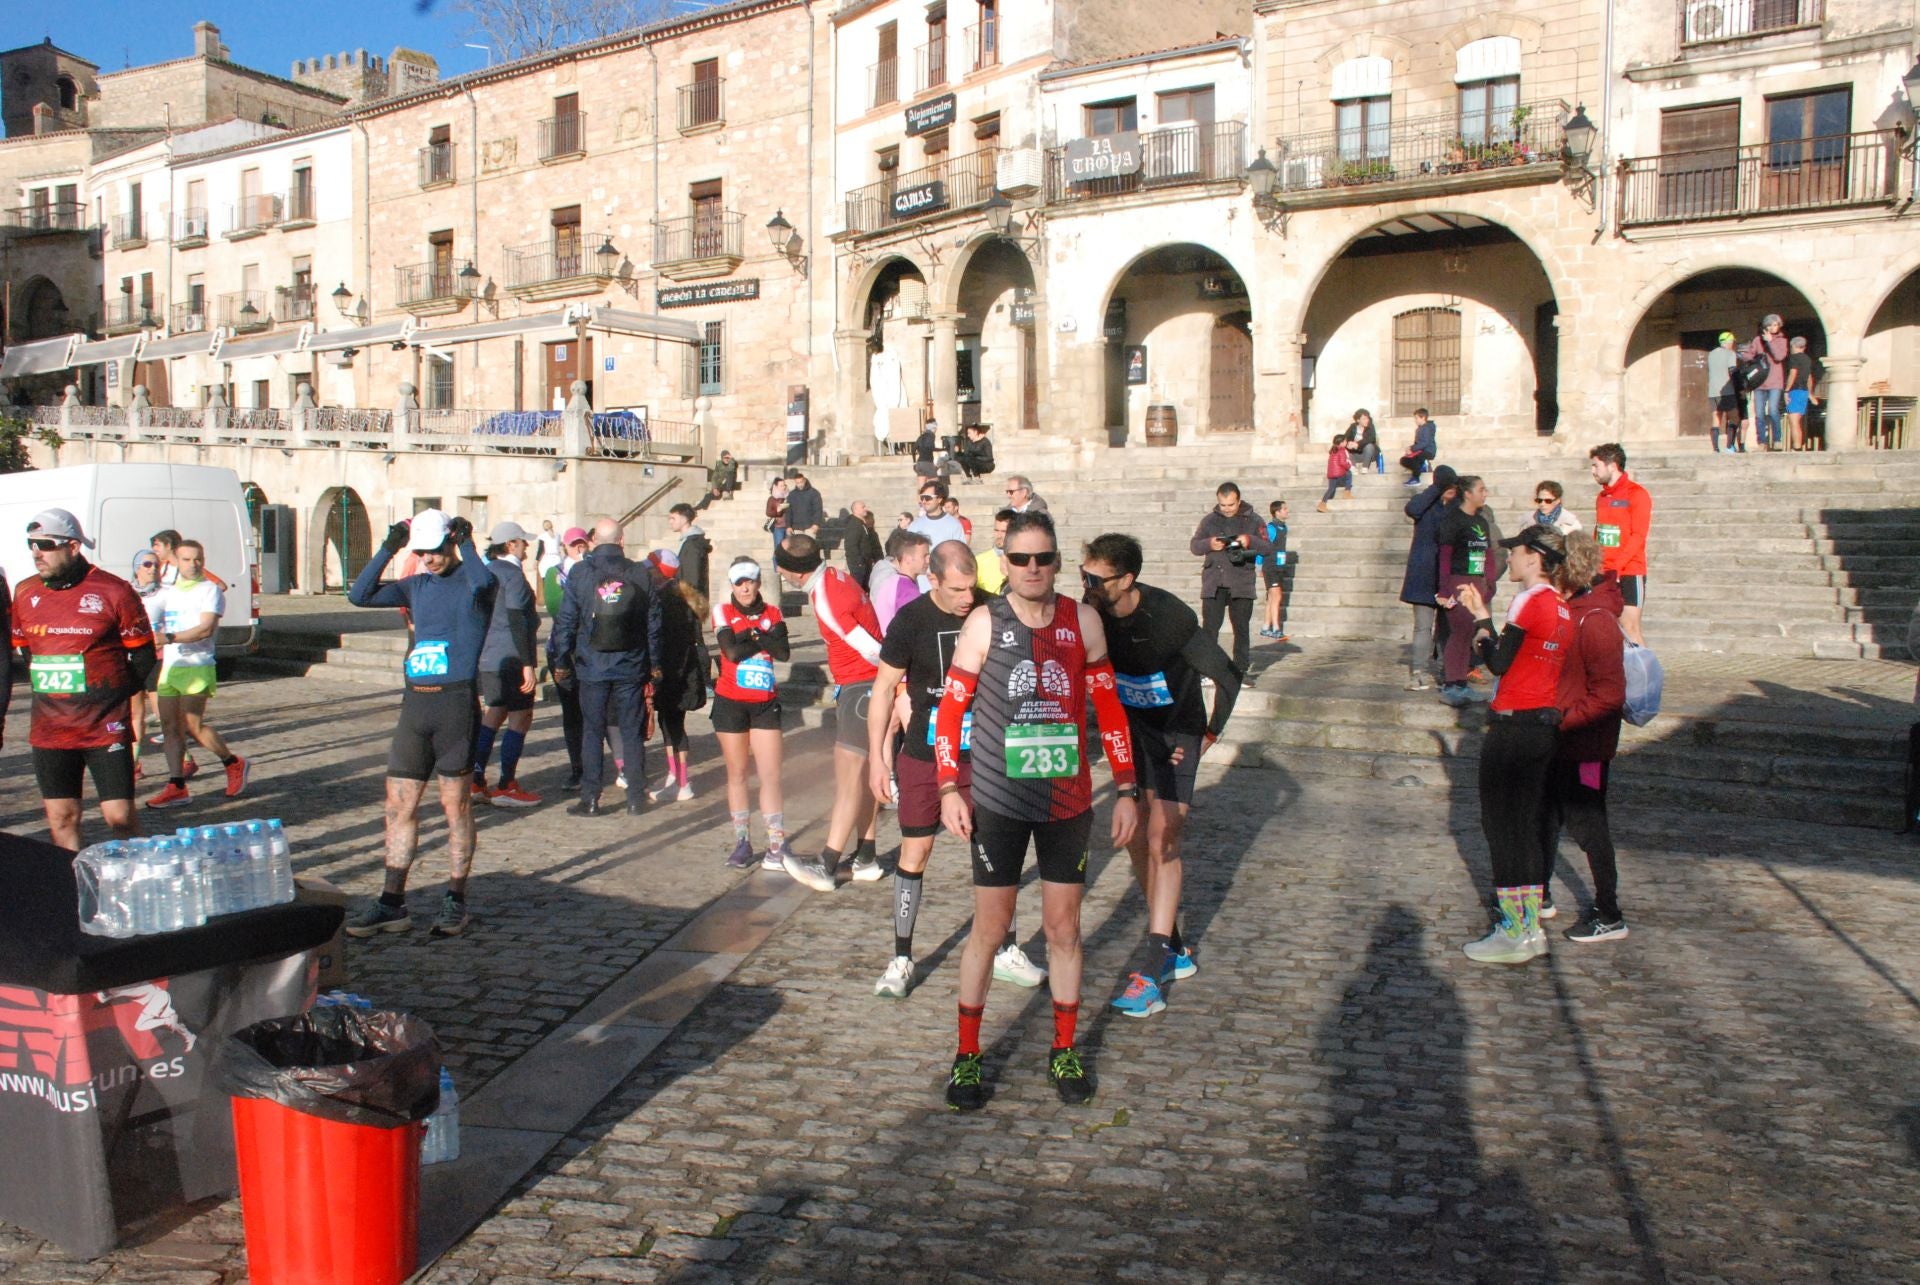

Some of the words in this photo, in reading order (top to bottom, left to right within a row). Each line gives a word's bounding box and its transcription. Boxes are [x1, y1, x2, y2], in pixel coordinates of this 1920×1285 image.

[908, 100, 952, 121] Alojamientos
[1092, 138, 1113, 155] LA
[1071, 151, 1133, 174] TROYA
[895, 187, 933, 211] CAMAS
[695, 288, 706, 298] LA
[47, 626, 93, 635] aquaducto
[411, 653, 438, 674] 547
[37, 671, 74, 690] 242
[744, 671, 771, 688] 563
[1125, 687, 1161, 705] 566
[1020, 748, 1068, 773] 233
[900, 888, 911, 918] HEAD
